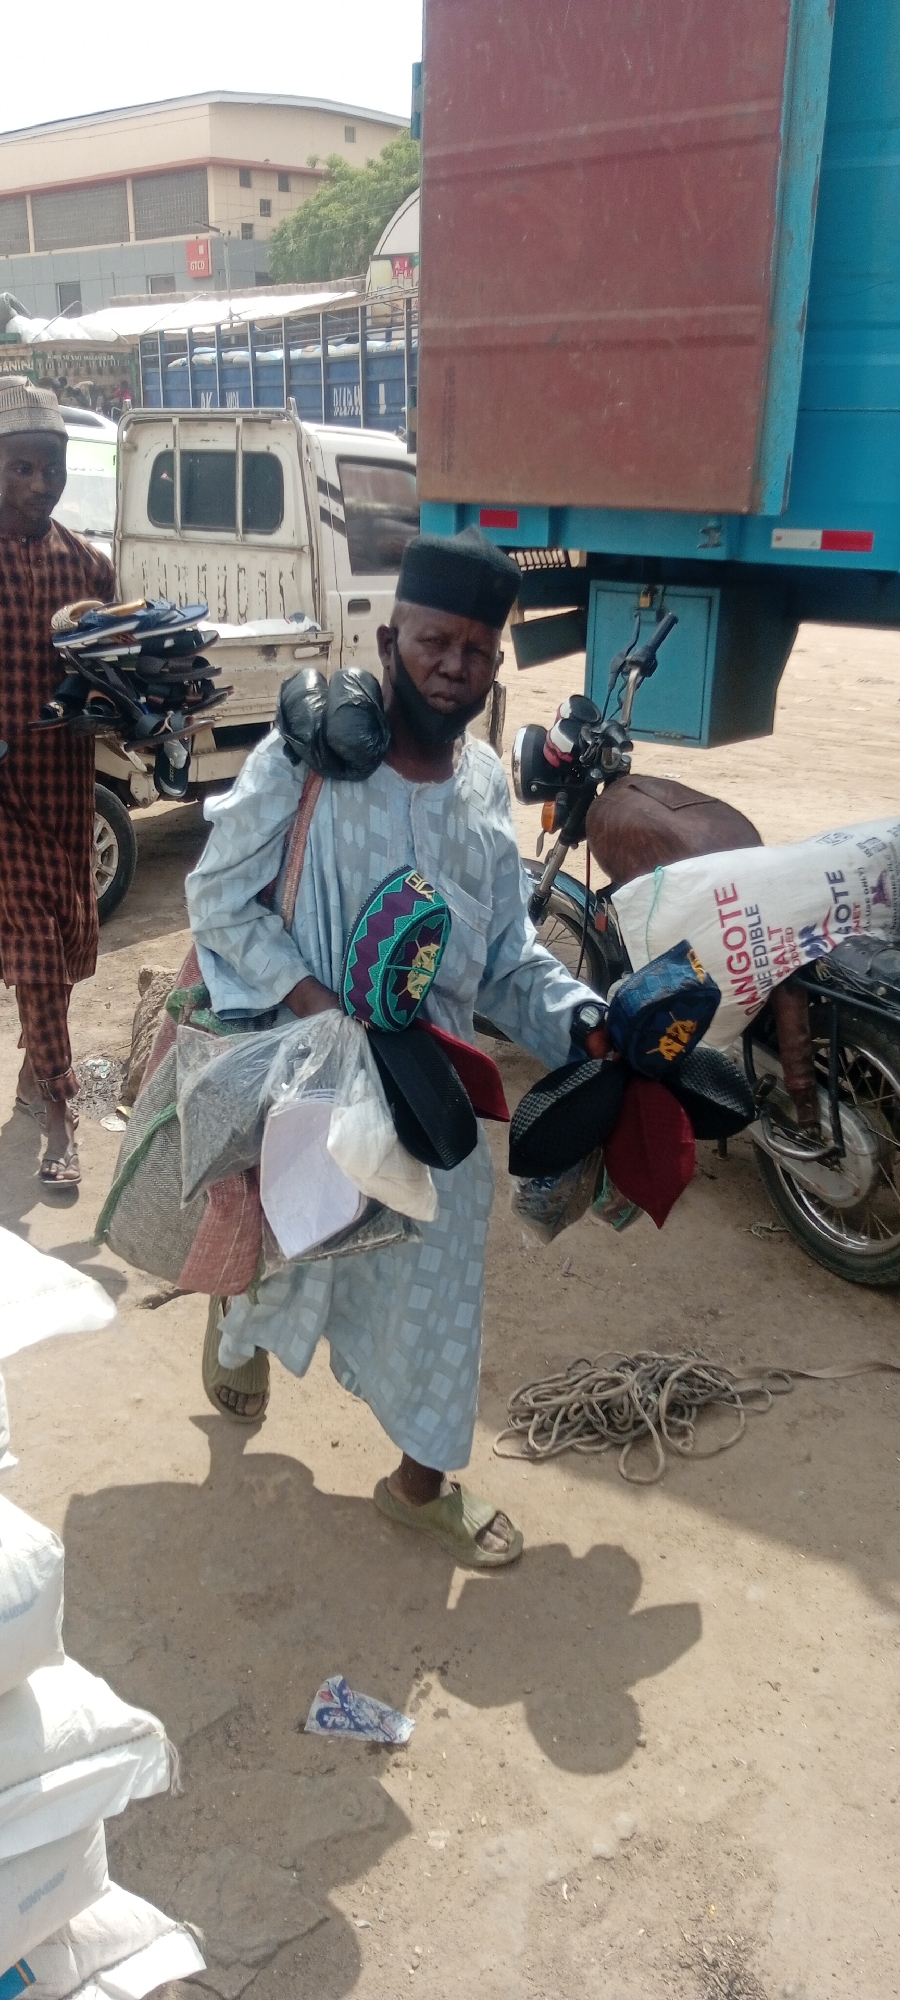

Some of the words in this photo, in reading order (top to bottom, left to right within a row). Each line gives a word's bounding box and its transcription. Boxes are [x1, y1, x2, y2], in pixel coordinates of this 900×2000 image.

[190, 261, 205, 270] GTCO
[824, 870, 852, 934] GOTE
[744, 904, 769, 969] EDIBLE
[767, 926, 792, 978] SALT
[785, 926, 801, 968] ODIZED
